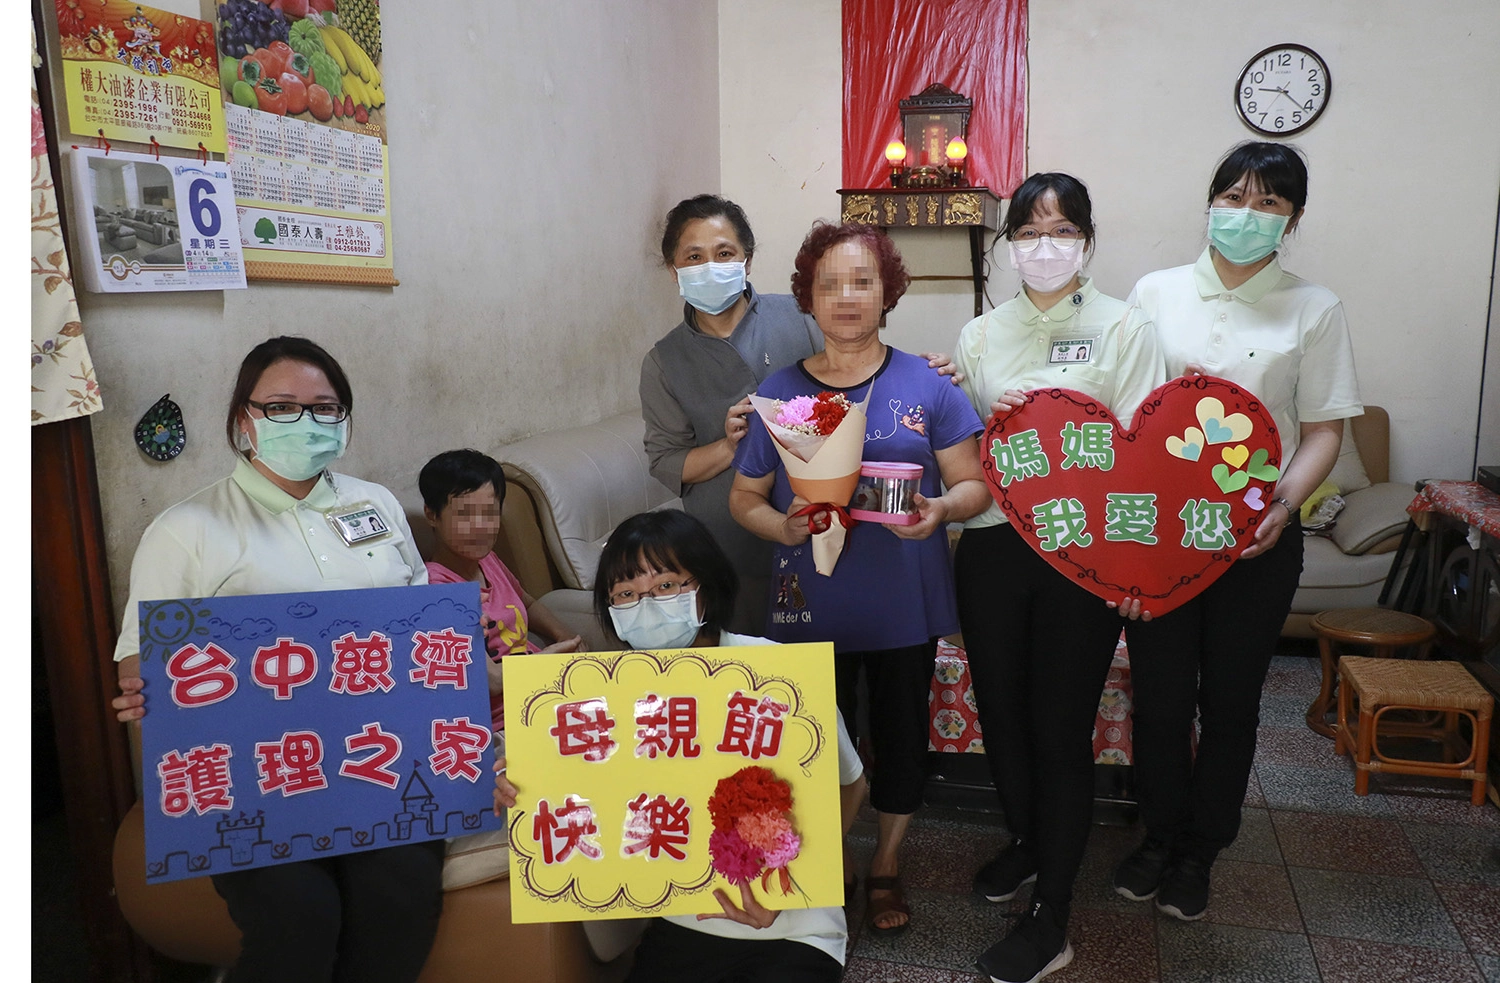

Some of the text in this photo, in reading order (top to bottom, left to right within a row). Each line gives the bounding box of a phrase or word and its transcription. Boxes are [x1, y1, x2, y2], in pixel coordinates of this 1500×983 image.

[1263, 59, 1273, 71] 11
[1278, 53, 1291, 66] 12
[1250, 71, 1264, 84] 10
[1308, 69, 1317, 81] 2
[80, 67, 211, 112] 權大油漆企業有限公司
[1243, 87, 1253, 99] 9
[1311, 84, 1320, 96] 3
[1247, 101, 1257, 113] 8
[1304, 100, 1314, 111] 4
[1258, 112, 1268, 124] 7
[1274, 116, 1284, 128] 6
[1292, 111, 1302, 123] 5
[365, 122, 381, 132] 2020
[189, 178, 221, 237] 6
[278, 223, 324, 240] 國泰人壽
[190, 238, 230, 249] 星期三
[991, 421, 1114, 487] 媽媽
[1032, 493, 1237, 551] 我愛您
[166, 627, 473, 708] 台中慈濟
[550, 690, 789, 762] 母親節
[157, 717, 492, 817] 護理之家
[532, 793, 690, 865] 快樂
